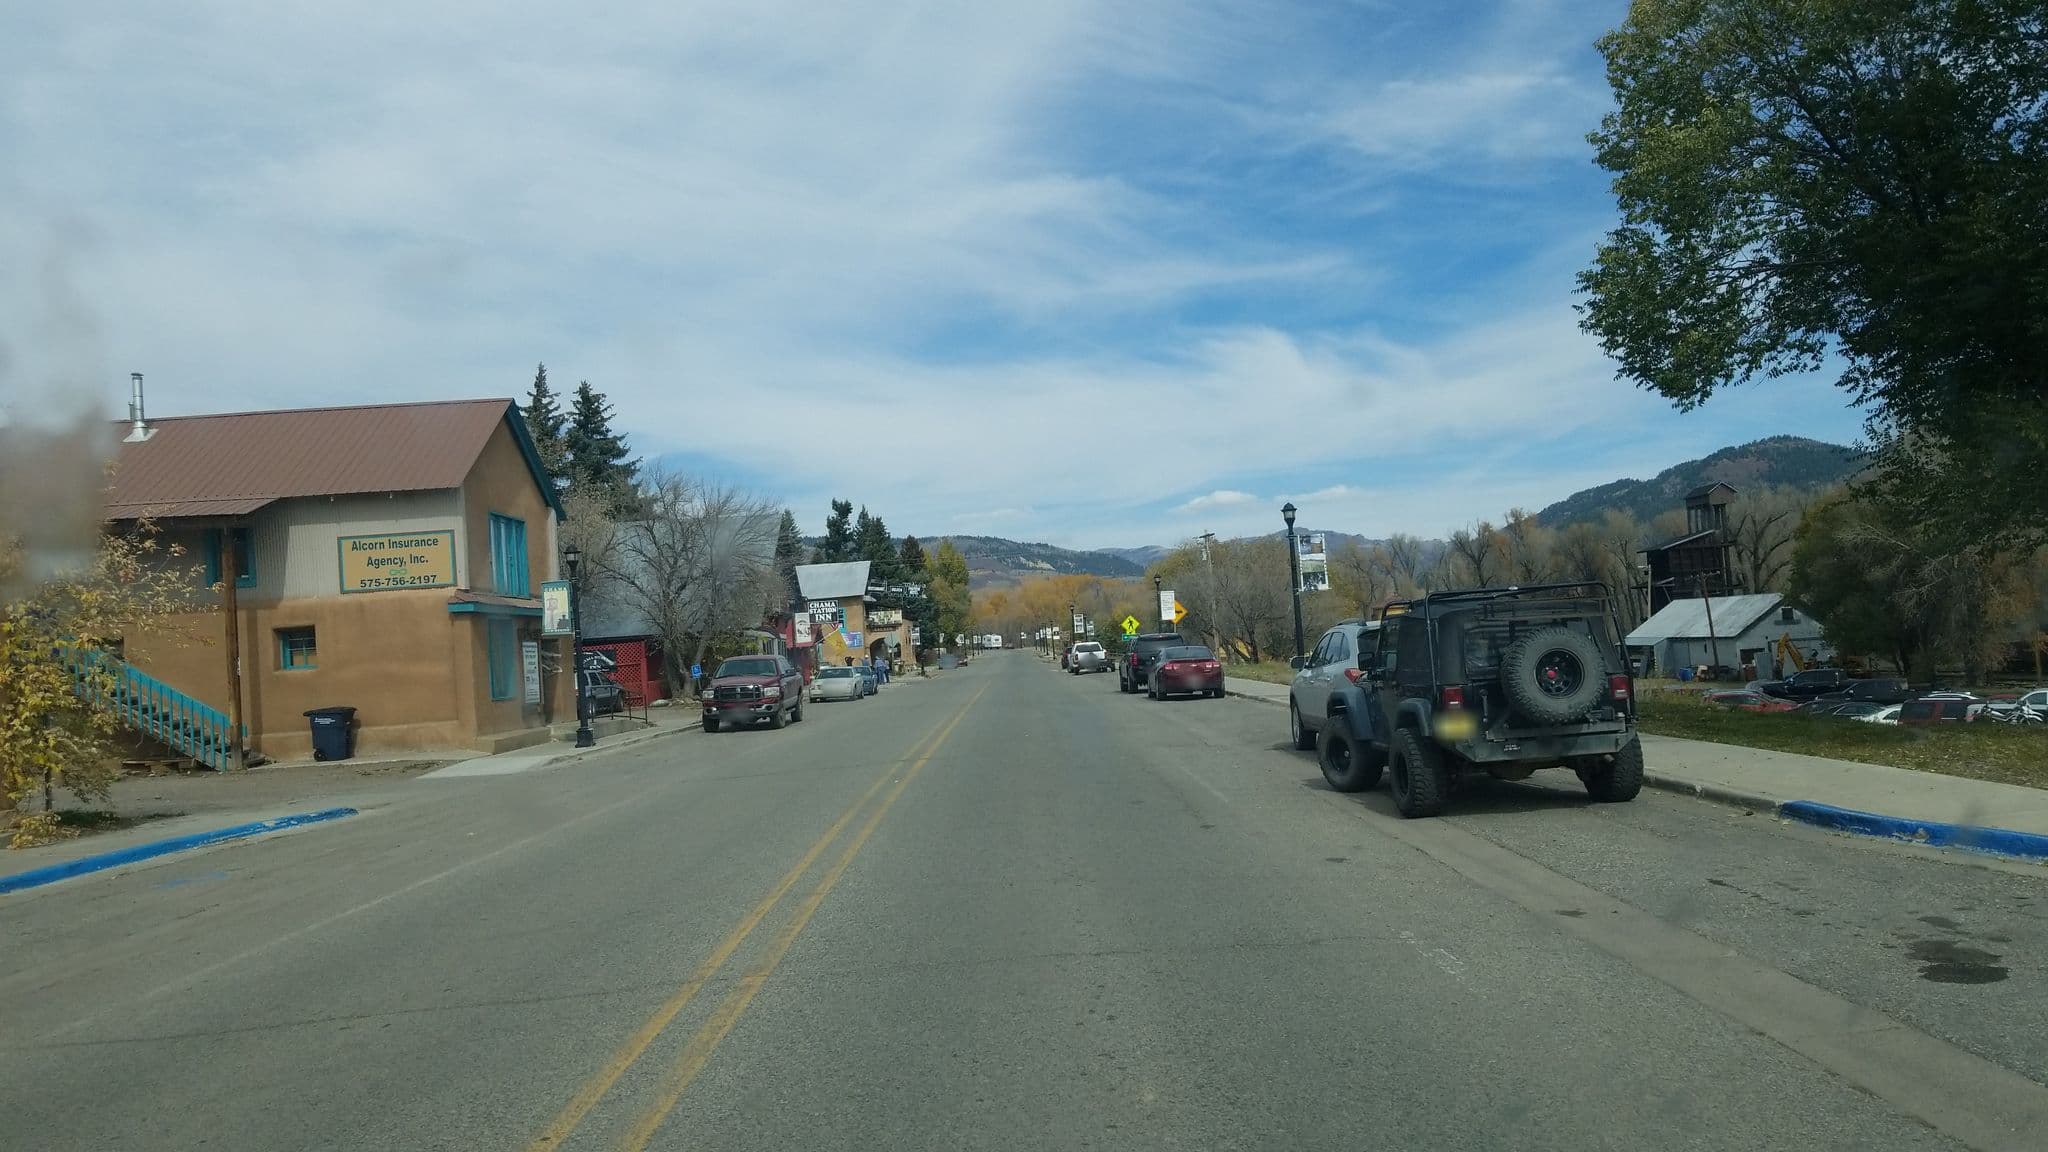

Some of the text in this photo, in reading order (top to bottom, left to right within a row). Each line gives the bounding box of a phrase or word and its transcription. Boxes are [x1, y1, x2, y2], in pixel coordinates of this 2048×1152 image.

[351, 537, 439, 552] Alcorn Insurance
[366, 554, 429, 569] Agency, Inc.
[360, 575, 437, 588] 575-756-2197
[815, 613, 832, 621] INN
